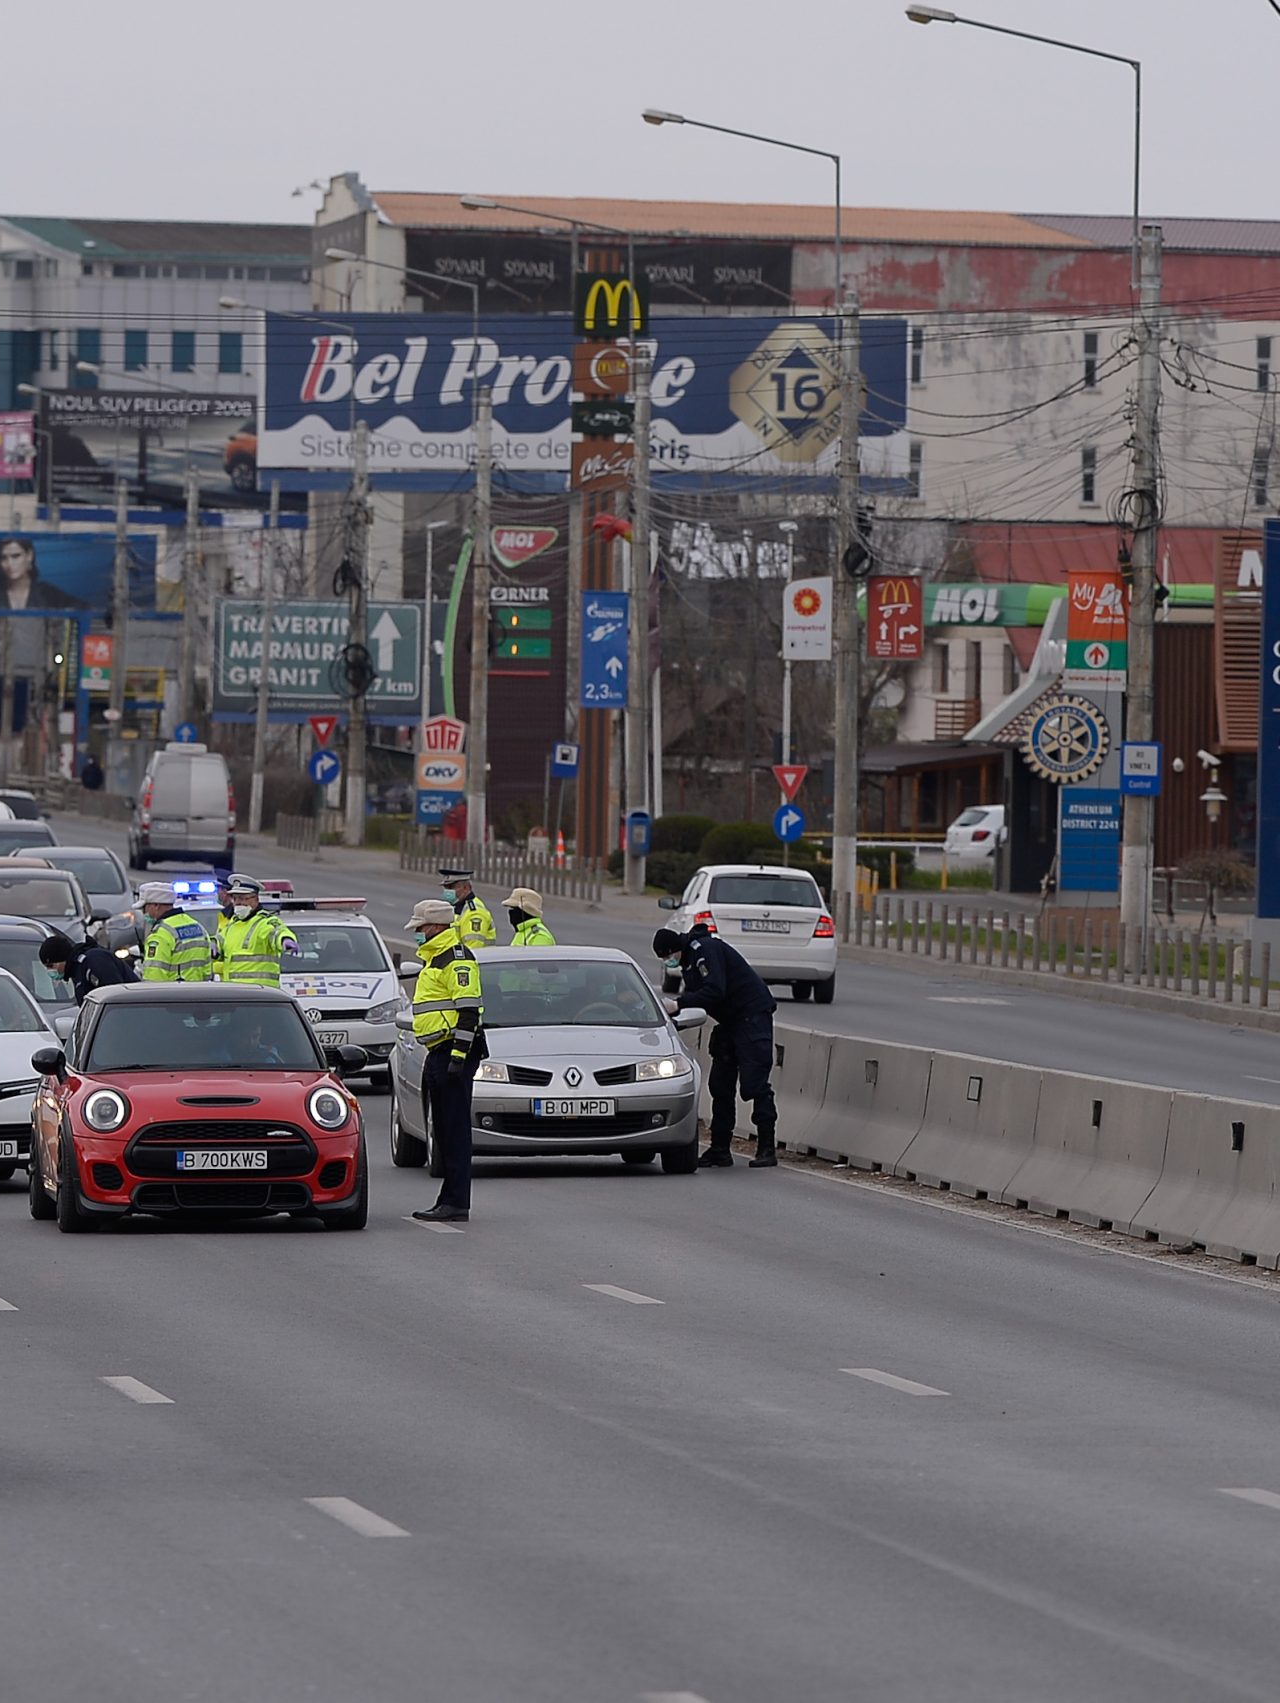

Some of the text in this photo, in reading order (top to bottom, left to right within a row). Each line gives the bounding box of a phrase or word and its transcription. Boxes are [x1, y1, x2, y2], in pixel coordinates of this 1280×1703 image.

[300, 335, 696, 408] Bel Proe
[771, 373, 825, 413] 16
[100, 396, 133, 412] SUV
[410, 437, 534, 465] compete
[538, 439, 569, 460] de
[499, 532, 535, 548] MOL
[931, 587, 1000, 623] MOL
[229, 667, 321, 687] GRANIT
[386, 678, 414, 693] km
[425, 766, 458, 778] DKV
[545, 1101, 609, 1115] B 01 MPD
[184, 1153, 196, 1168] B
